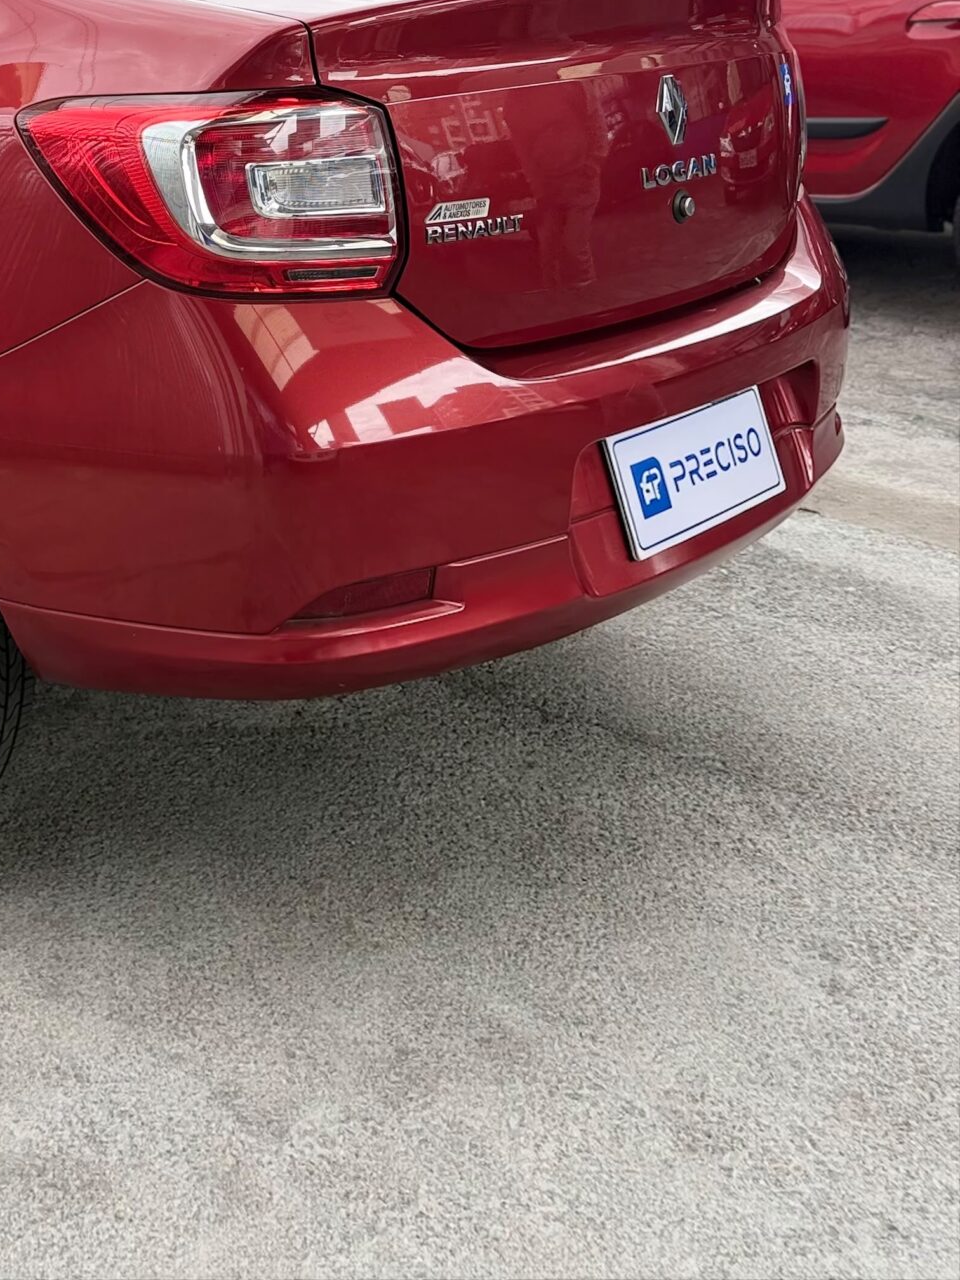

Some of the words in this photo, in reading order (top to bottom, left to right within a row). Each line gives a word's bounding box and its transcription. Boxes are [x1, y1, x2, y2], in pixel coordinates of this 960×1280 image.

[641, 153, 717, 189] LOGAN
[442, 211, 447, 219] &
[448, 209, 471, 219] ANEXOS
[444, 200, 487, 211] AUTOMOTORES
[426, 214, 524, 245] RENAULT
[669, 427, 761, 493] PRECISO
